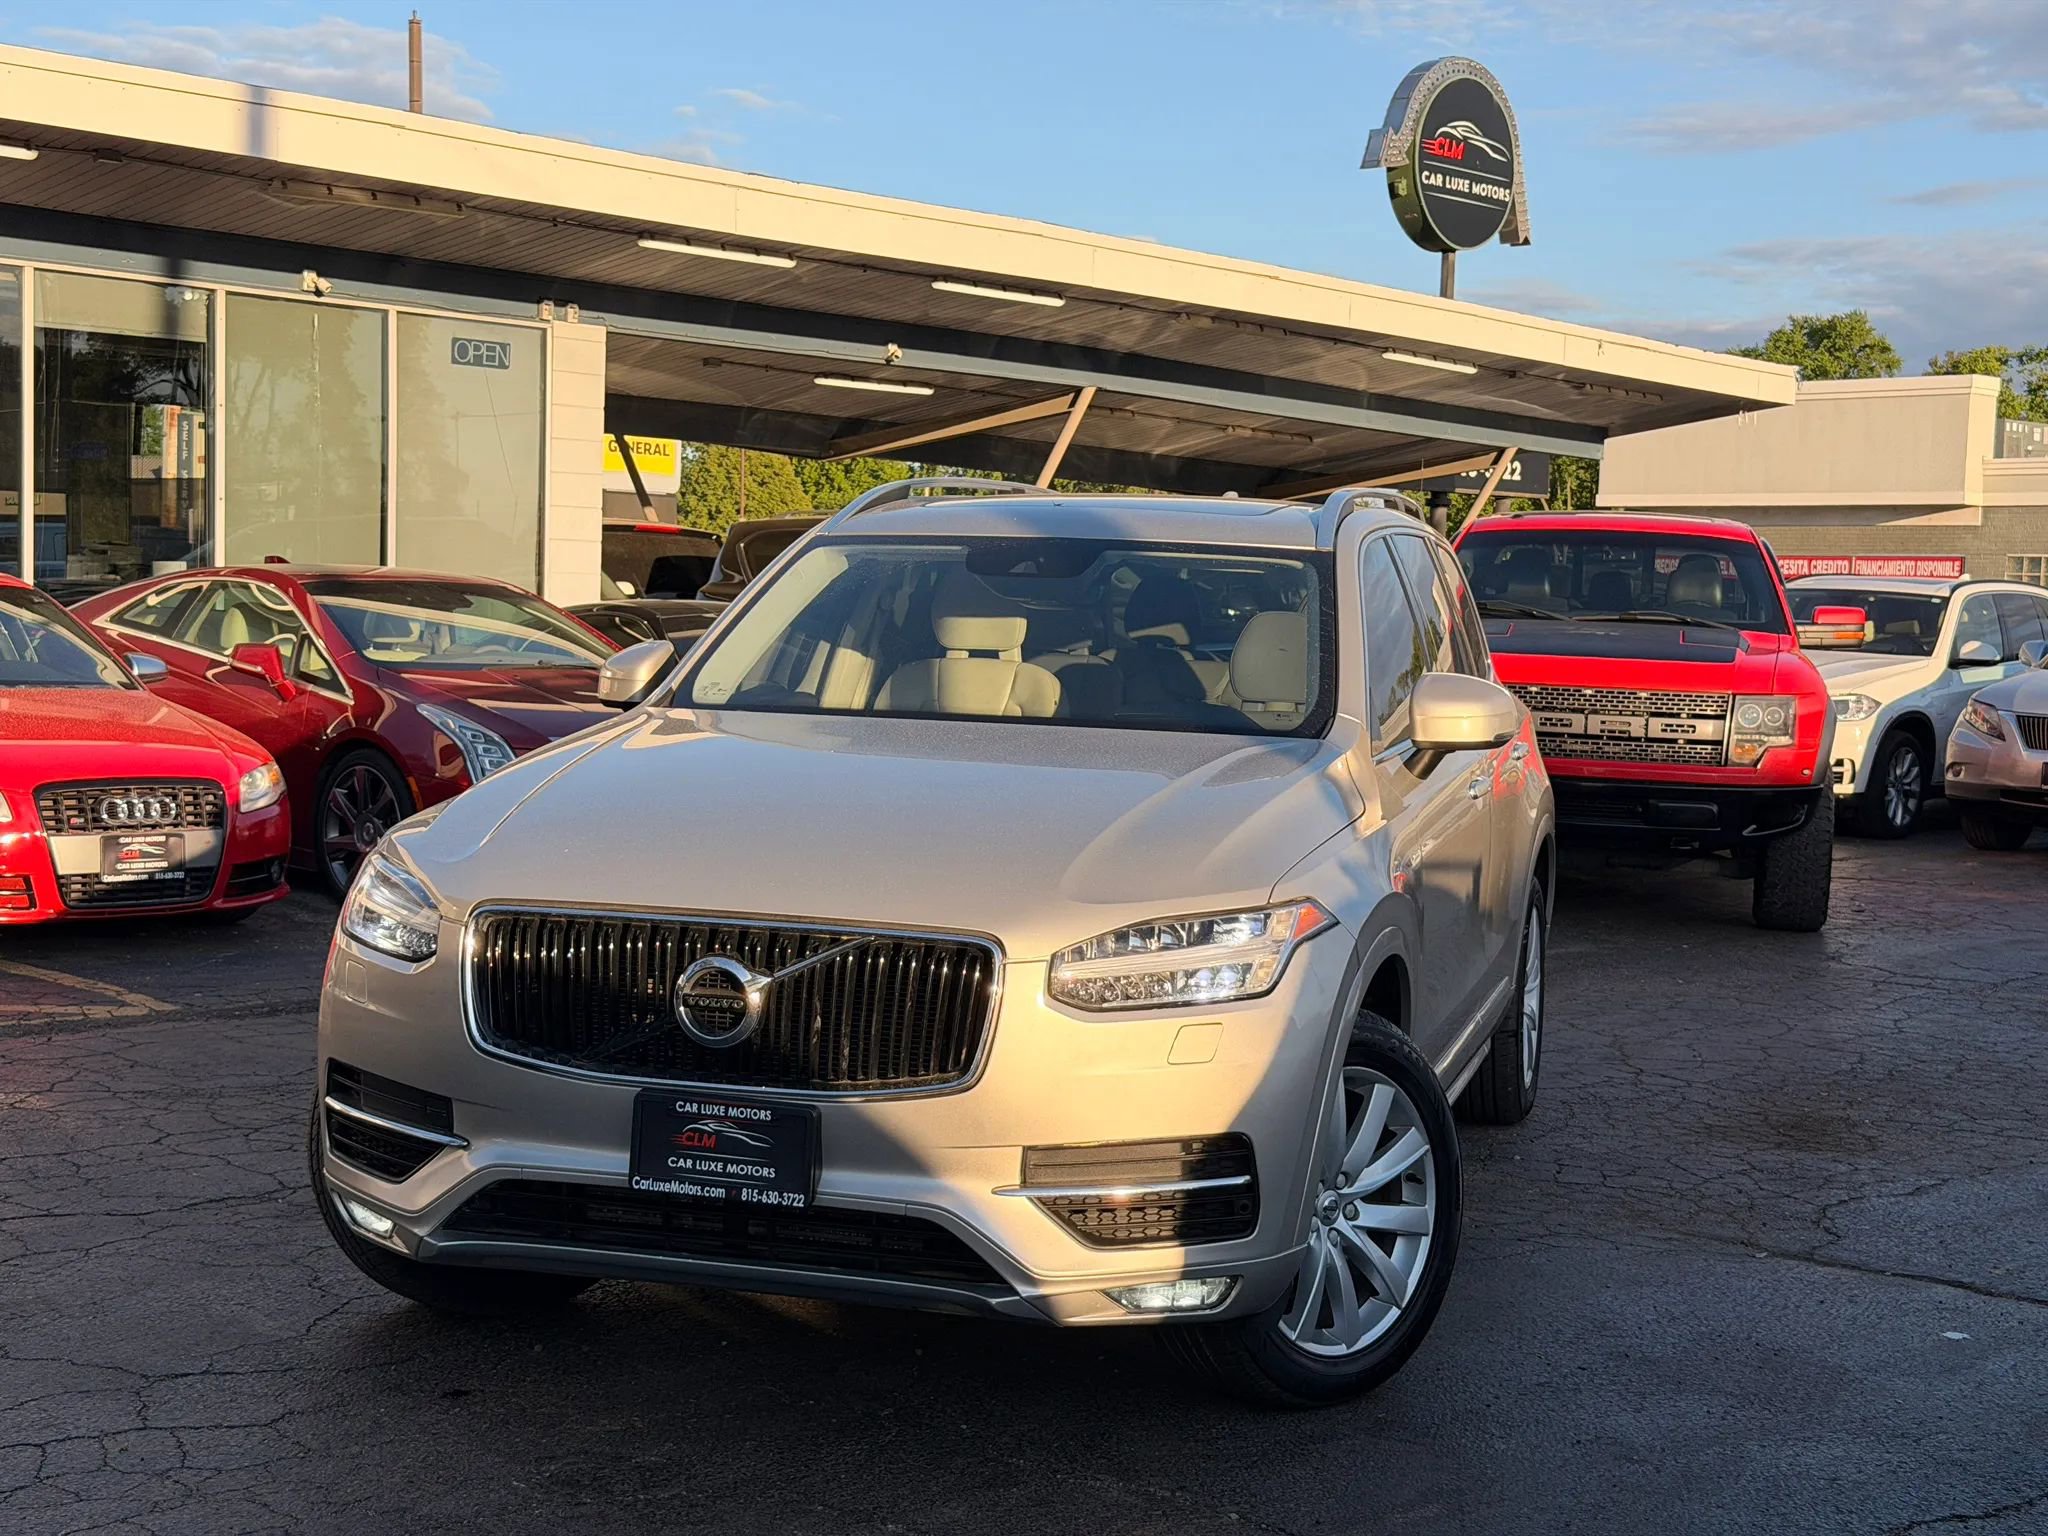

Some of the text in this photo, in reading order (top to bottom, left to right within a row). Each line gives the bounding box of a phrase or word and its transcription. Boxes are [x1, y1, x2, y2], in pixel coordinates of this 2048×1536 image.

[1434, 136, 1464, 160] CLM
[1421, 170, 1511, 202] CAR LUXE MOTORS
[454, 340, 510, 366] OPEN
[181, 420, 190, 460] SELF
[608, 440, 670, 456] GNERAL
[1810, 559, 1848, 576] CREDITO
[1855, 560, 1961, 577] FINANCIAMIENTO DISPONIBLE
[687, 996, 744, 1009] VOLVO
[675, 1101, 772, 1121] CAR LUXE MOTORS
[683, 1131, 717, 1149] CLM
[667, 1156, 776, 1178] CAR LUXE MOTORS
[632, 1176, 805, 1207] CarLuxeMotors.com 815-630-3722
